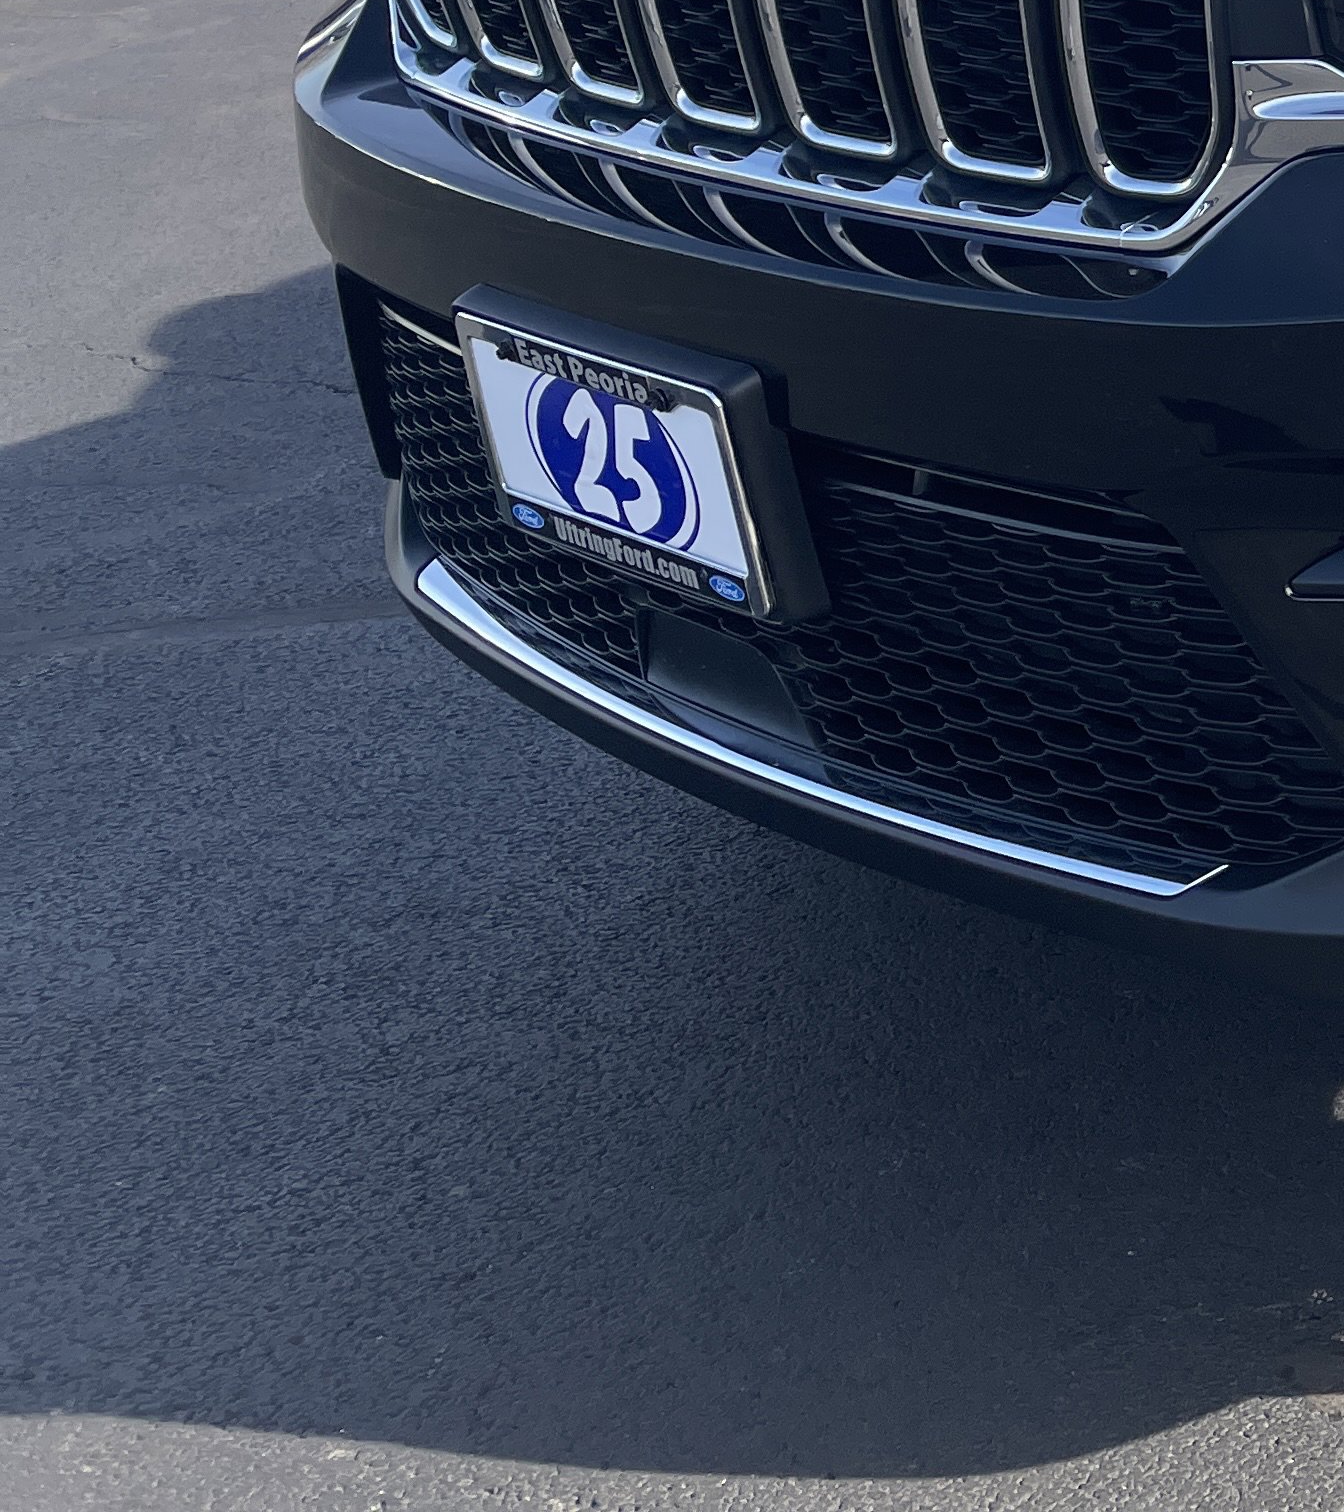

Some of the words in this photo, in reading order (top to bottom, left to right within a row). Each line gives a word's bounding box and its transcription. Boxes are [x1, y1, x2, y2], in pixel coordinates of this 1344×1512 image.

[514, 338, 567, 378] East
[567, 355, 649, 404] Peoria
[562, 387, 663, 535] 25
[553, 516, 700, 589] UftringFord.com
